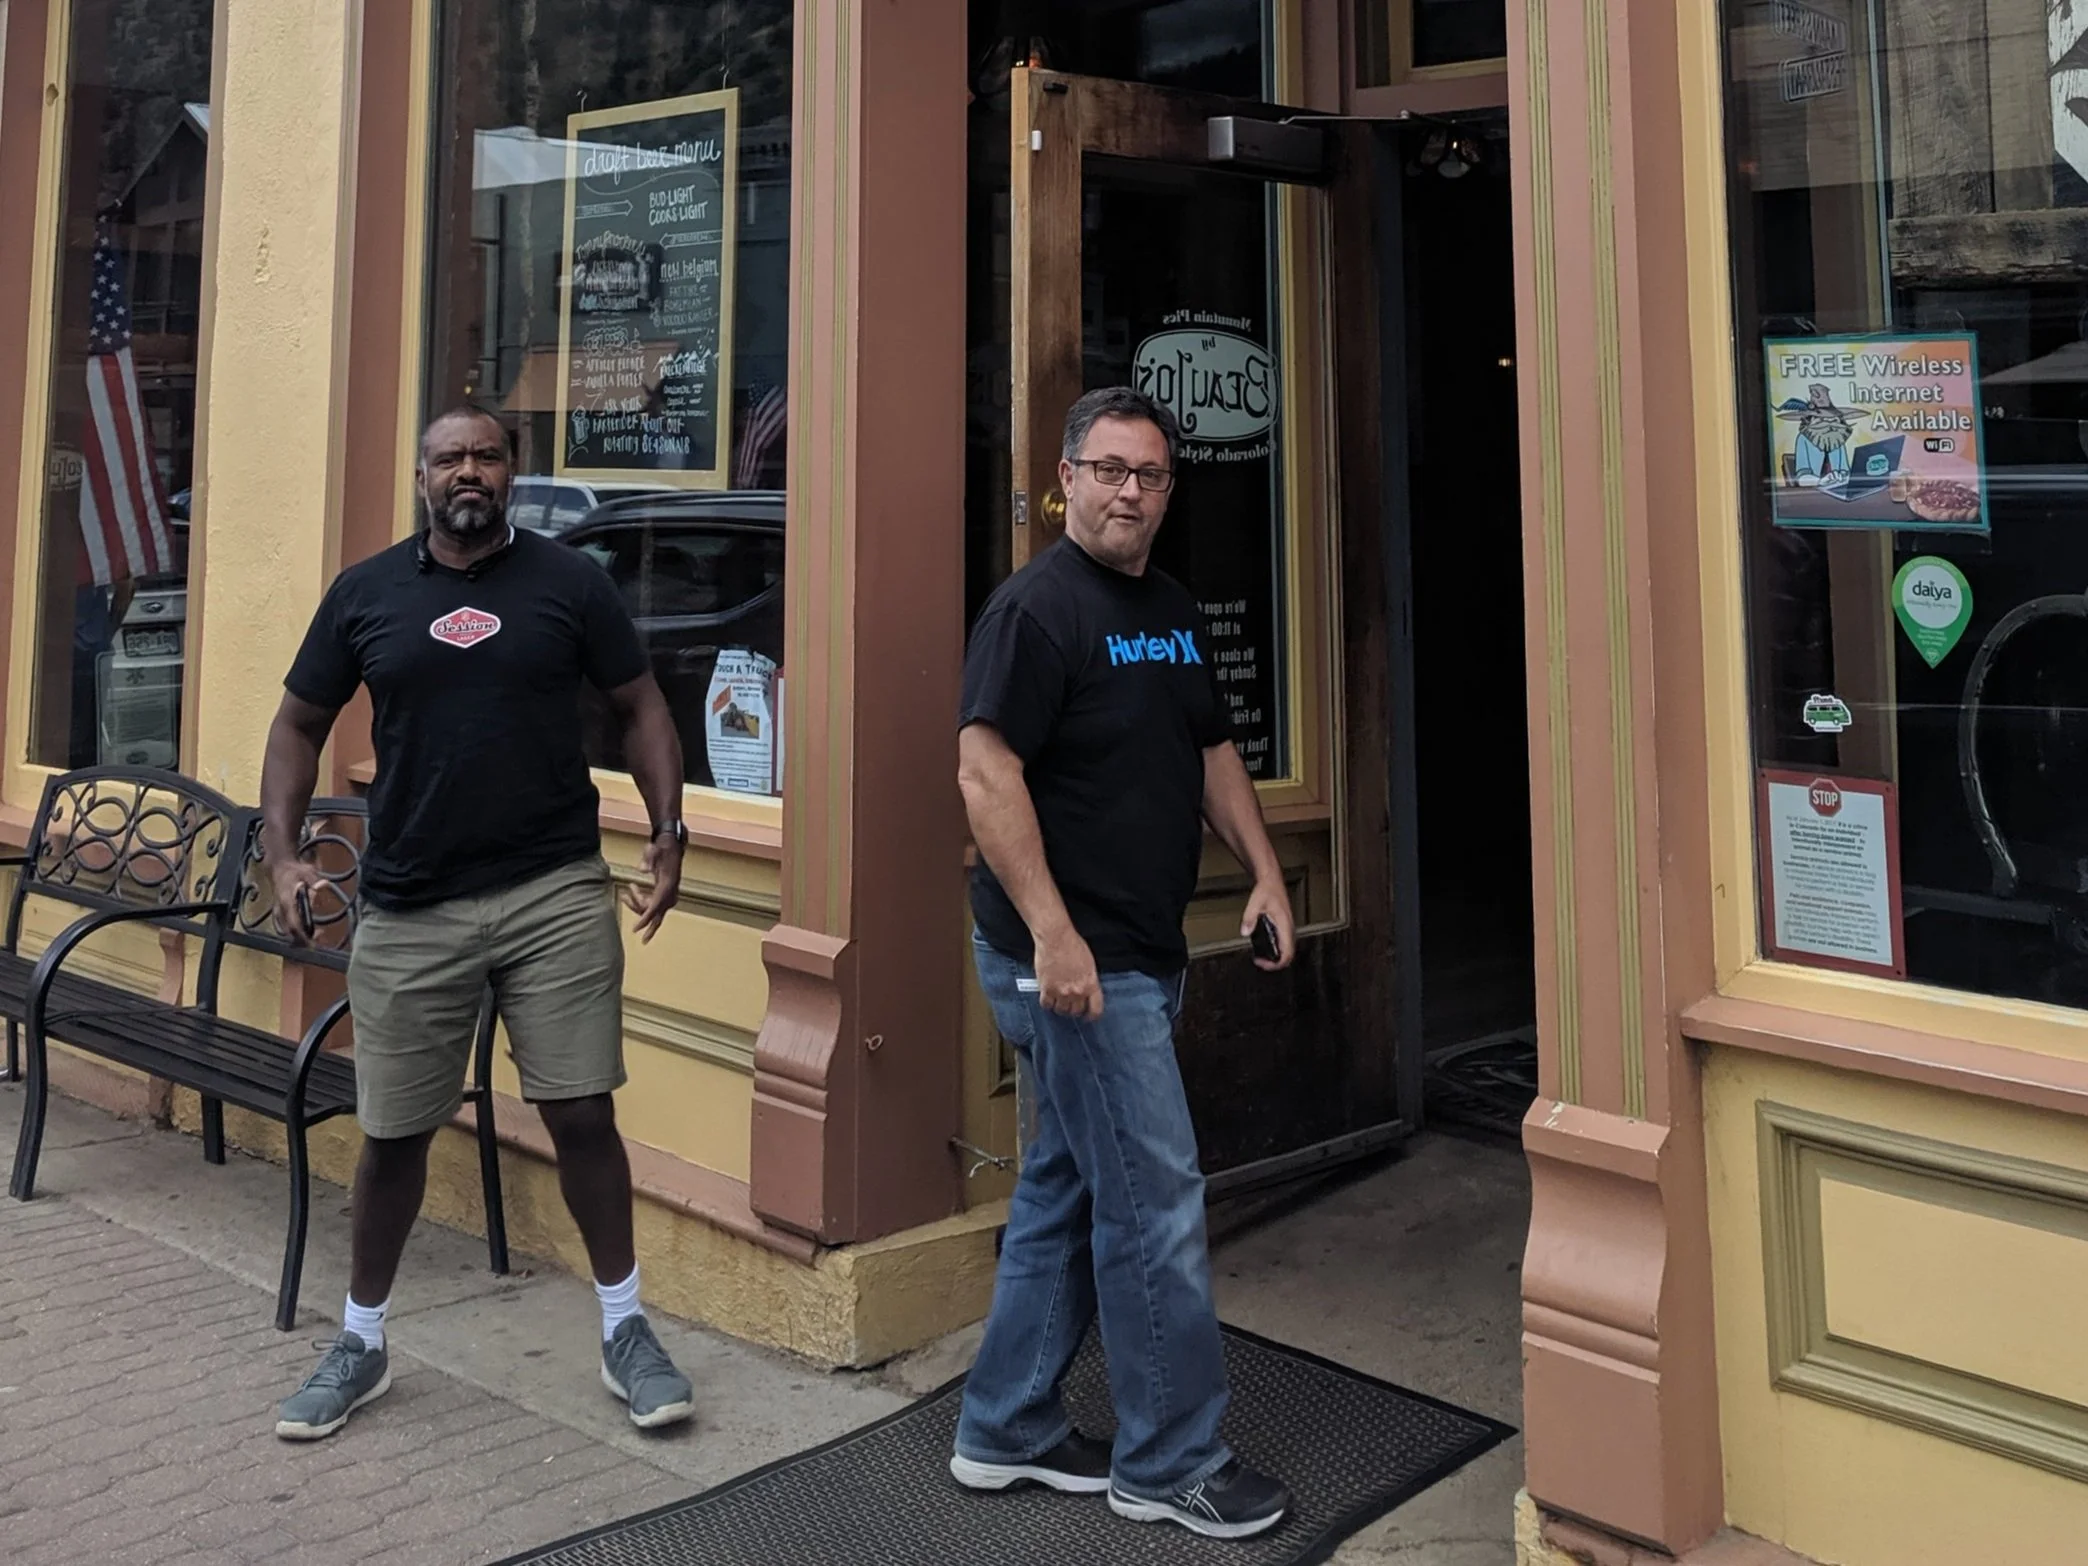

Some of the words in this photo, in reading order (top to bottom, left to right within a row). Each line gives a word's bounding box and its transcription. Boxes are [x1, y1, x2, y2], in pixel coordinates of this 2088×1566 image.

[584, 145, 631, 185] draft
[636, 141, 670, 169] beer
[674, 139, 722, 164] menu
[668, 185, 696, 206] LIGHT
[679, 201, 709, 222] LIGHT
[1780, 353, 1855, 377] FREE
[1862, 354, 1963, 375] Wireless
[1849, 382, 1944, 403] Internet
[1871, 410, 1972, 431] Available
[1912, 580, 1952, 601] daiya
[436, 619, 495, 635] Session
[1105, 631, 1176, 667] Hurley
[1812, 789, 1838, 806] STOP
